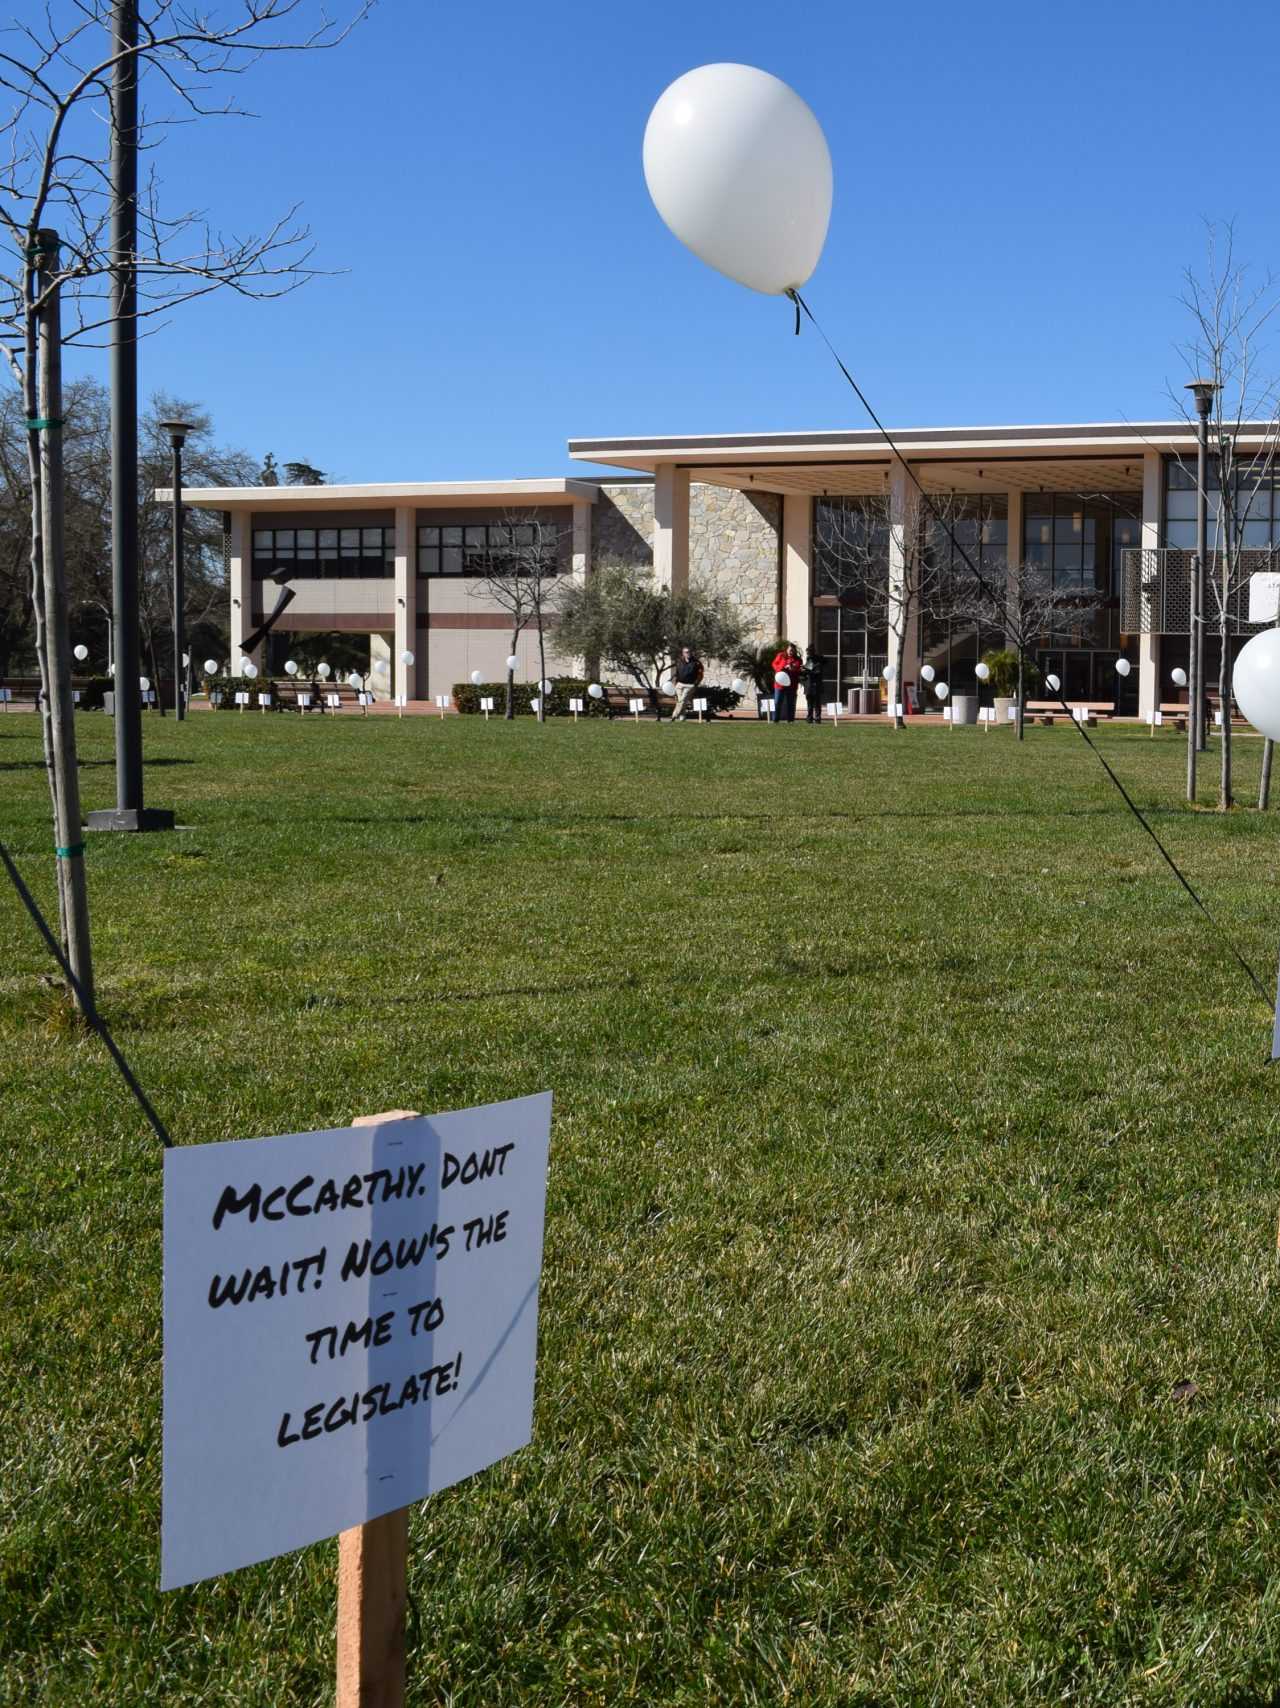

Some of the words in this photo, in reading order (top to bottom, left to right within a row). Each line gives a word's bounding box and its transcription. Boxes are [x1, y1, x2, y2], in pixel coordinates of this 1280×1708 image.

[207, 1247, 328, 1309] WAIT!
[340, 1223, 456, 1283] NOW'S
[463, 1209, 510, 1252] THE
[305, 1310, 396, 1365] TIME
[407, 1297, 445, 1337] TO
[276, 1352, 463, 1449] LEGISLATE!
